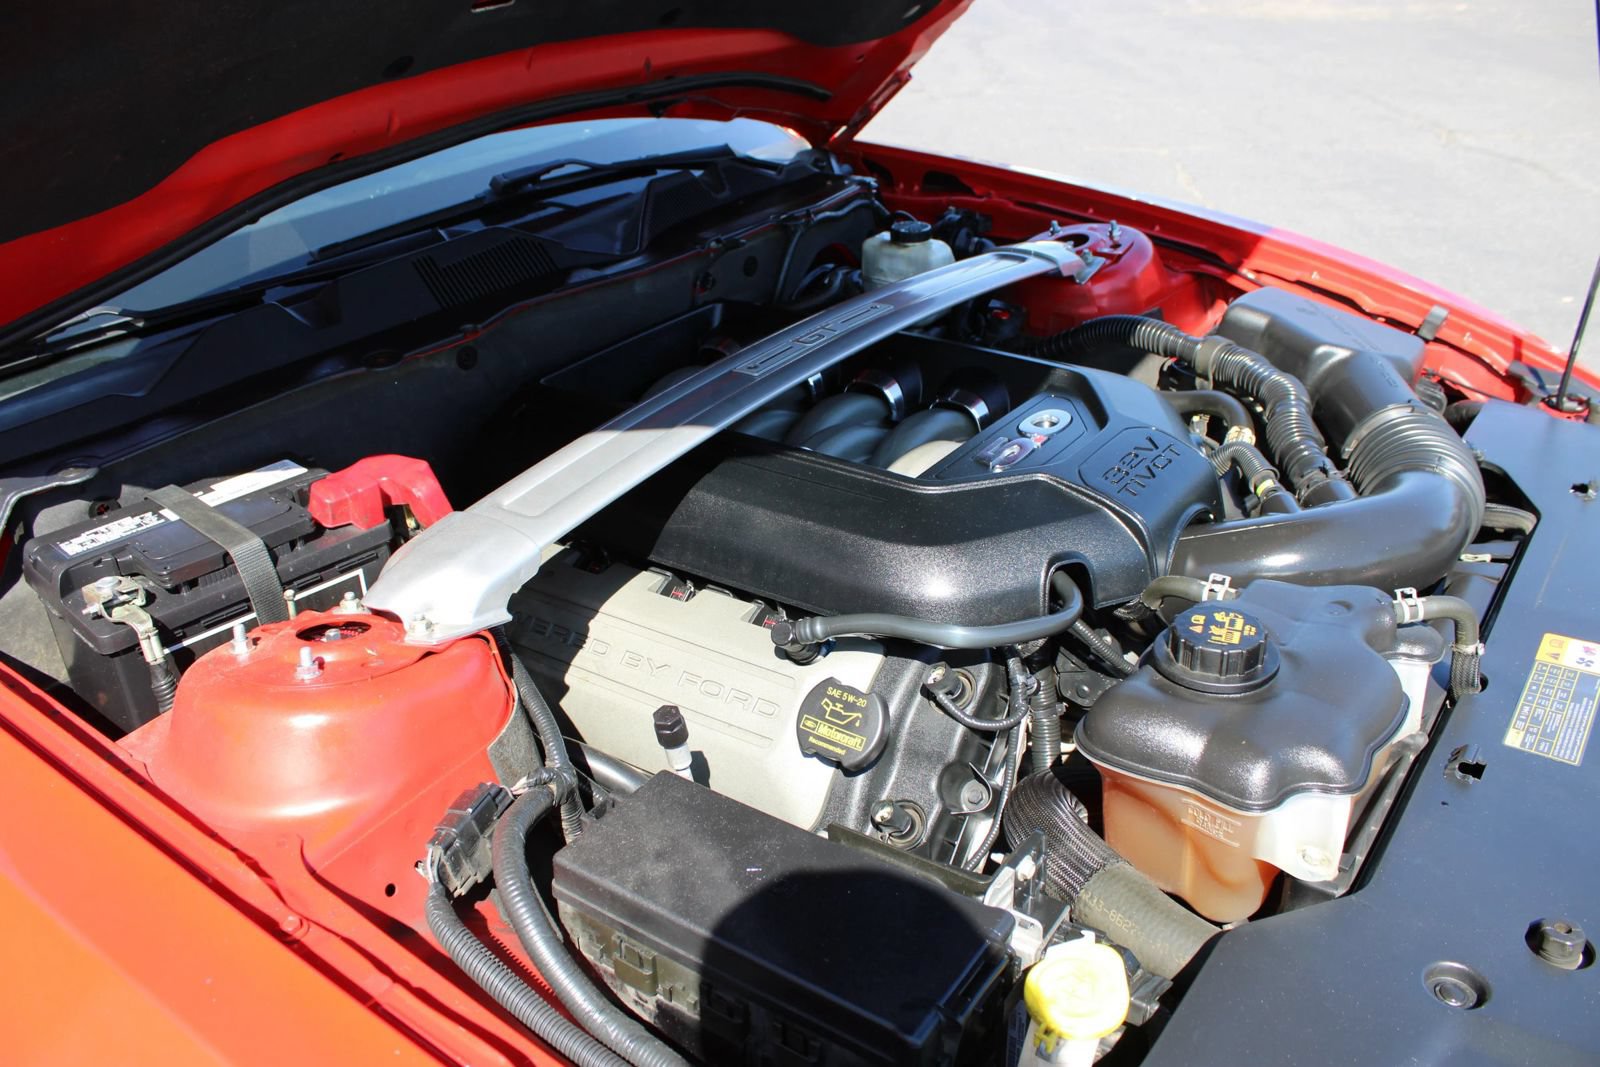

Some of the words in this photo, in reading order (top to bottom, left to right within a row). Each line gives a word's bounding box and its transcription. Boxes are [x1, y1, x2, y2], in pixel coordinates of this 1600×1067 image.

[791, 322, 838, 345] GT
[1102, 436, 1160, 485] 32V
[514, 612, 610, 657] WERED
[620, 649, 672, 677] BY
[677, 669, 781, 719] FORD
[826, 686, 842, 699] SAE
[842, 692, 867, 708] 5W-20
